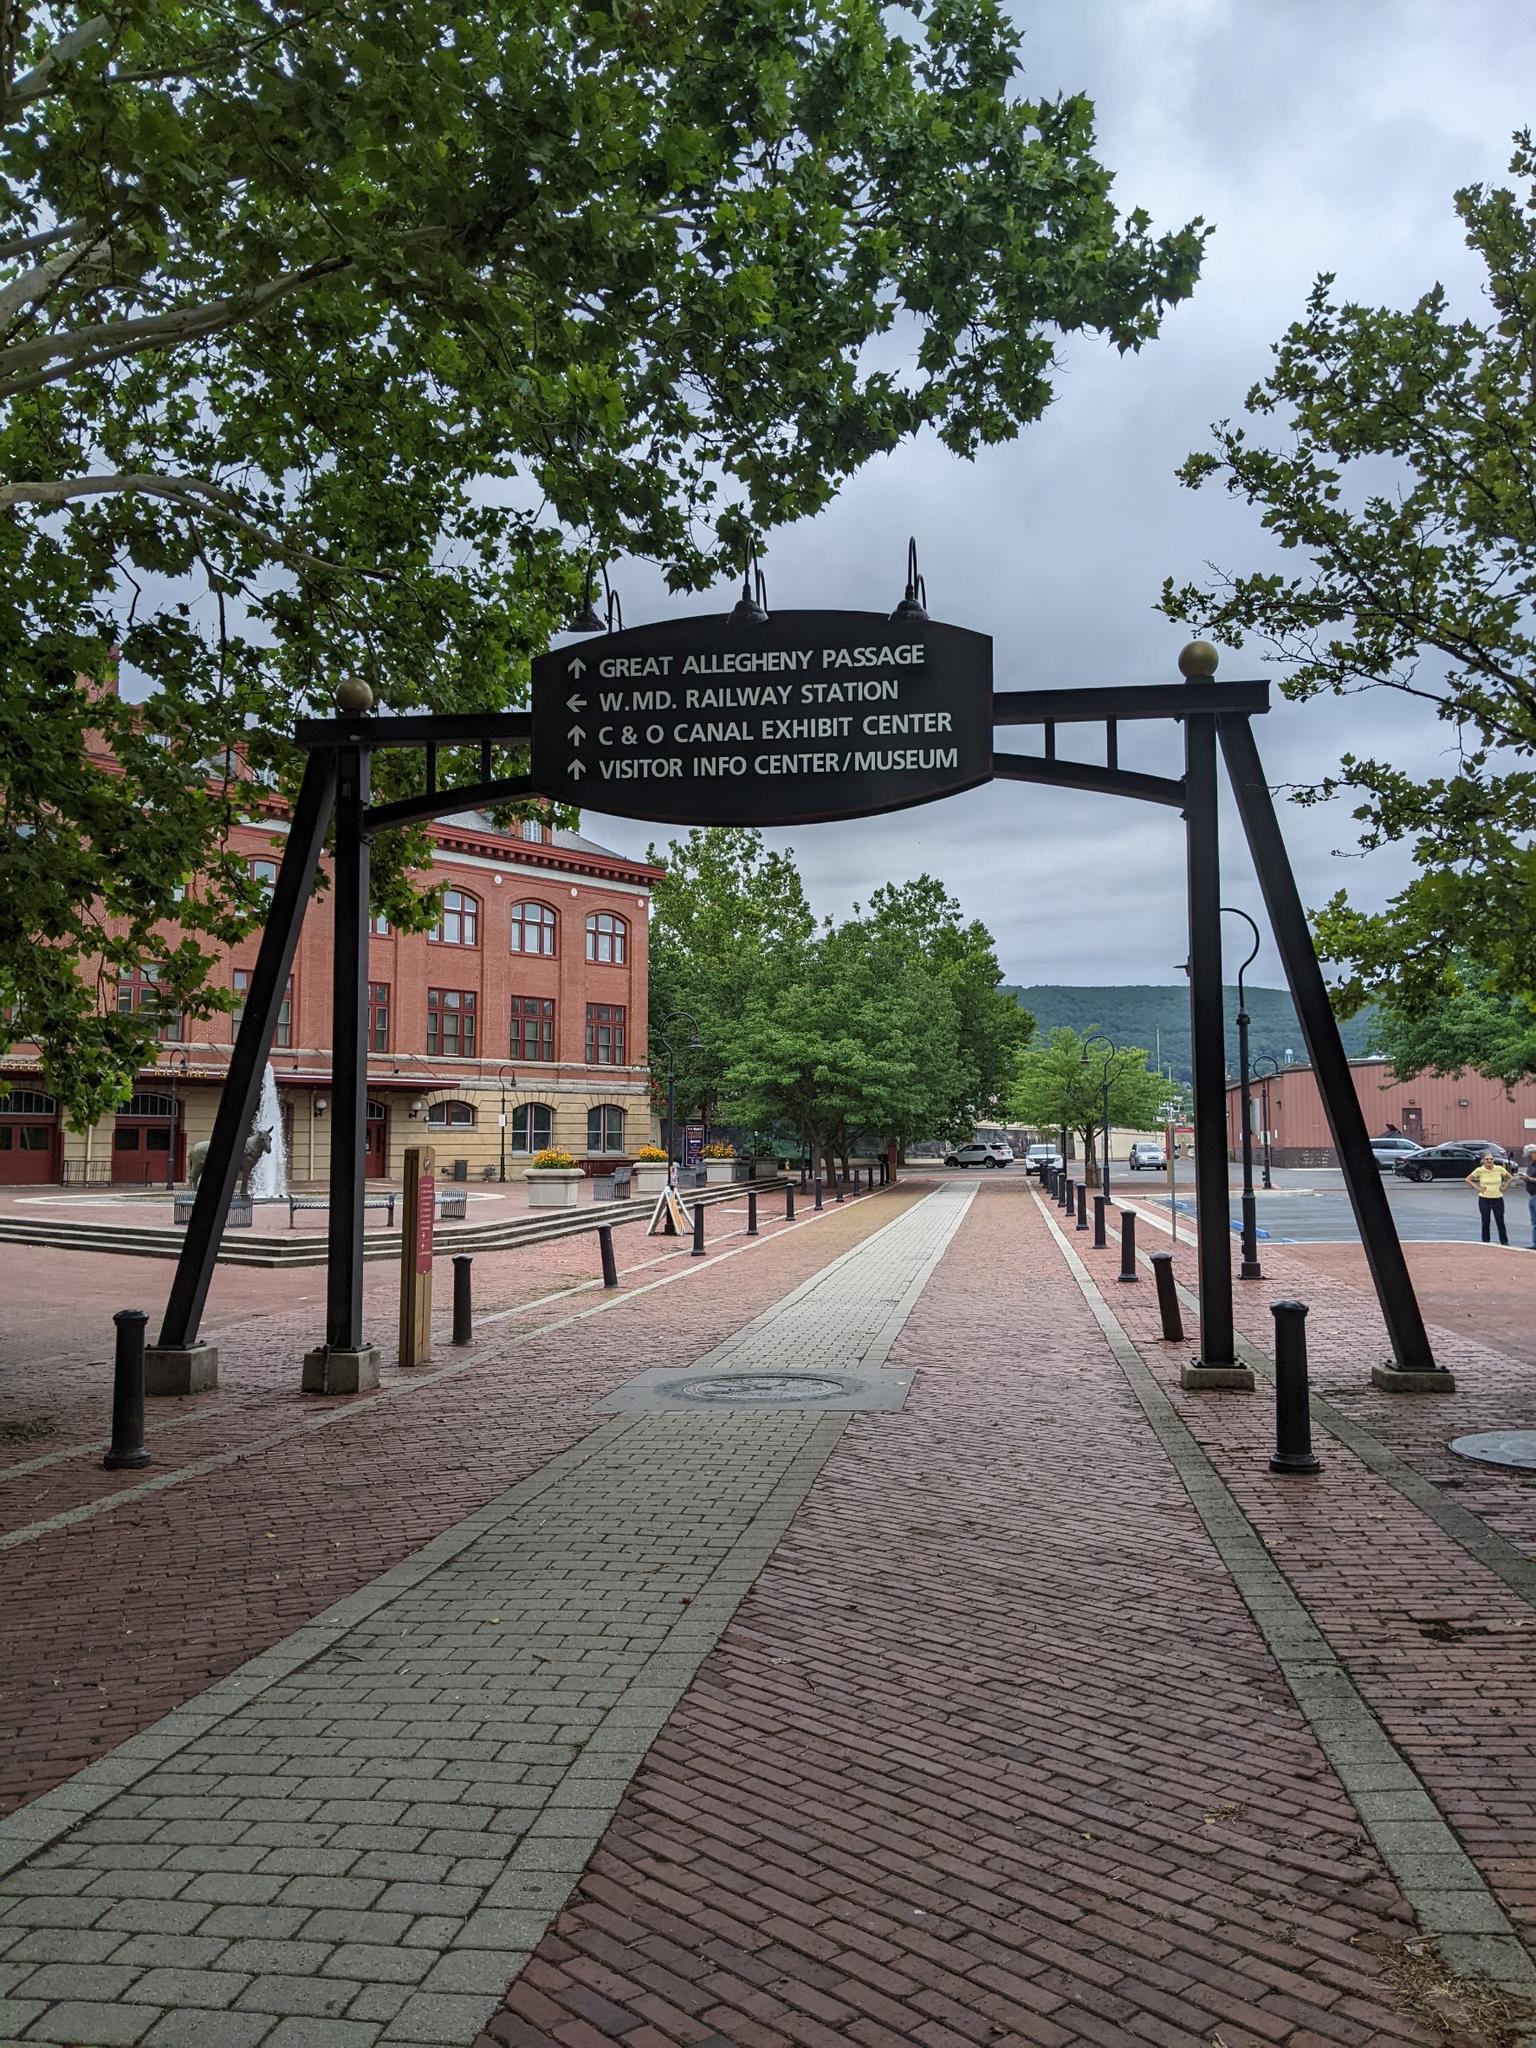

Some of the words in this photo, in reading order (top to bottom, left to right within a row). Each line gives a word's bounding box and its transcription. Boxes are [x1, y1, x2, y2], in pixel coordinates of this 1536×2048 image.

[599, 656, 674, 678] GREAT
[681, 650, 814, 675] ALLEGHENY
[822, 644, 925, 669] PASSAGE
[599, 690, 677, 712] W.MD.
[686, 684, 793, 709] RAILWAY
[801, 680, 898, 704] STATION
[598, 726, 613, 746] C
[621, 725, 638, 745] &
[646, 724, 664, 744] O
[673, 721, 754, 743] CANAL
[762, 716, 854, 740] EXHIBIT
[862, 712, 953, 736] CENTER
[599, 758, 683, 779] VISITOR
[693, 756, 747, 777] INFO
